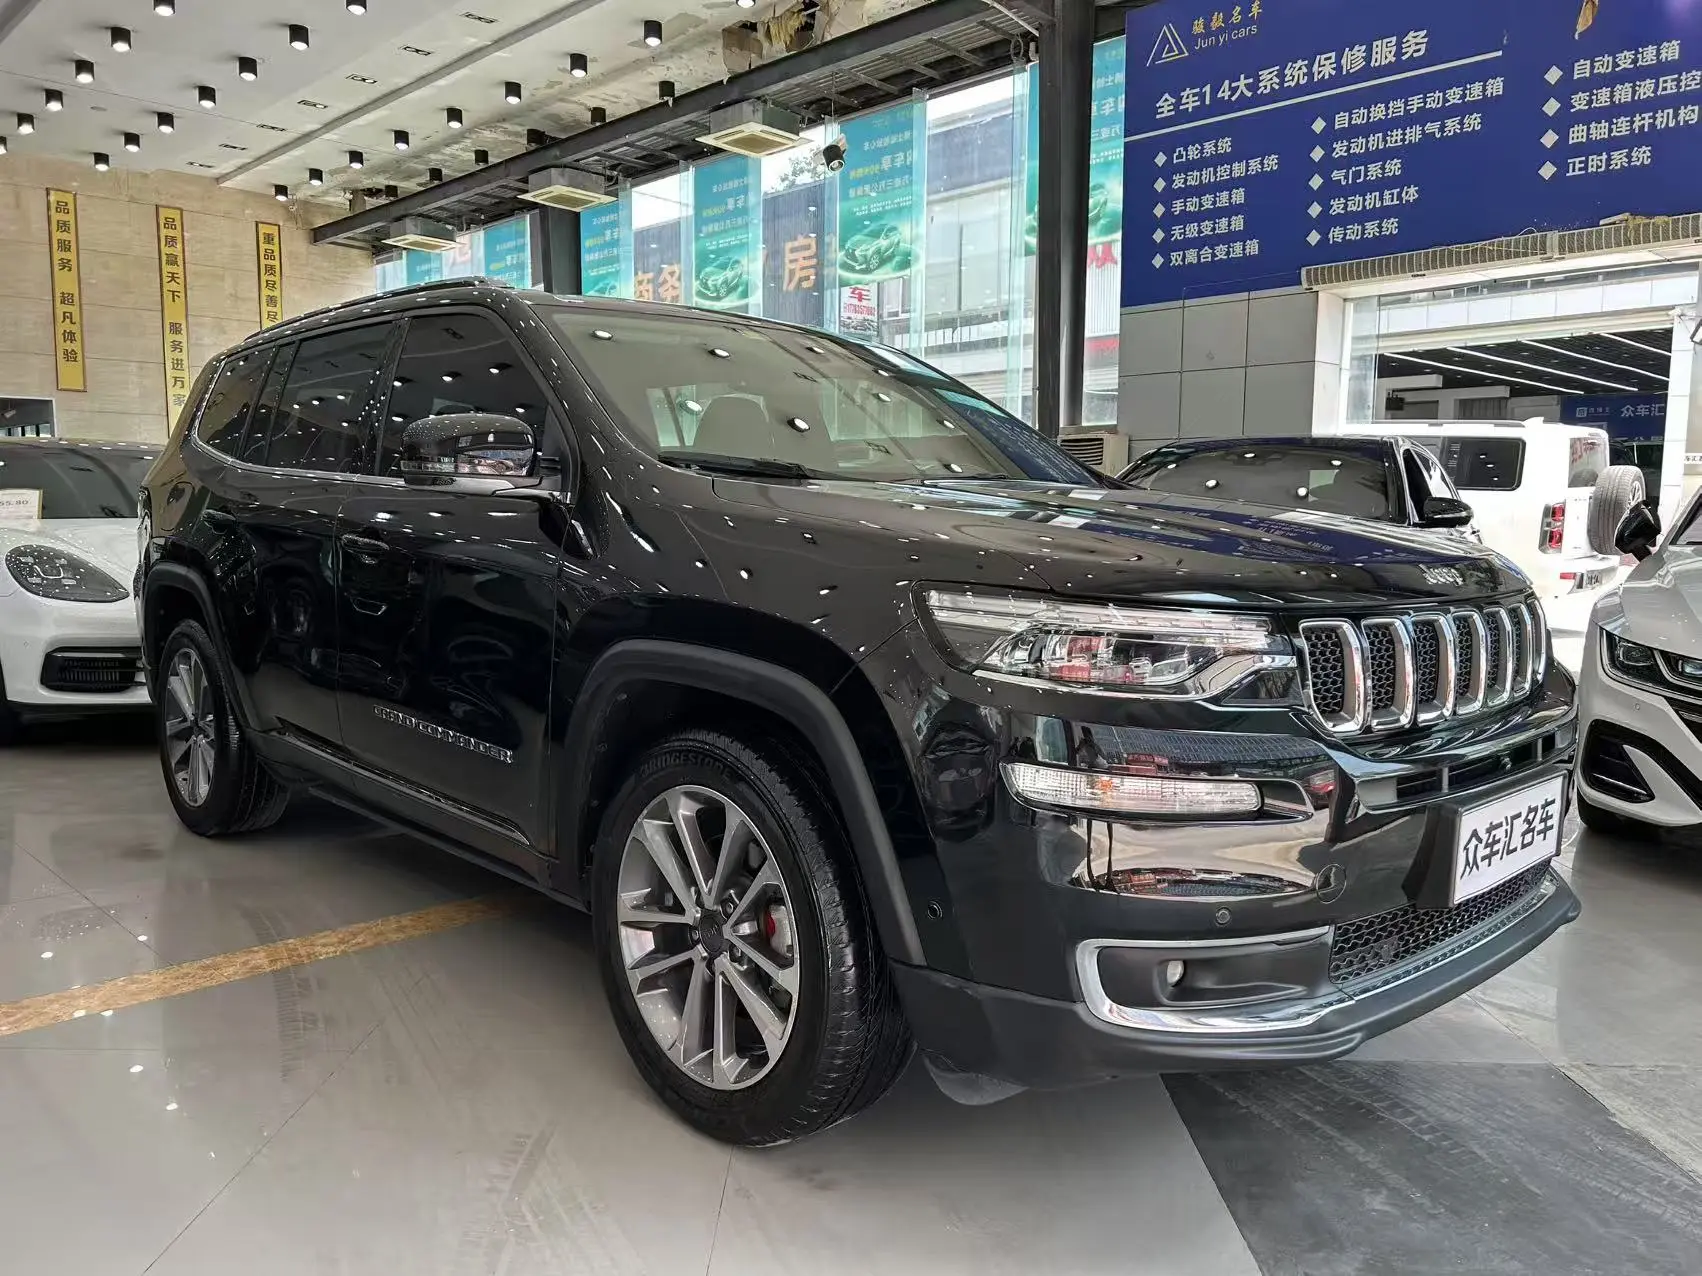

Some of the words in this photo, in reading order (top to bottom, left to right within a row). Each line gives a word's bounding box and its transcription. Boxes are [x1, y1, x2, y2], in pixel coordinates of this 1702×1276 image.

[1194, 34, 1215, 50] Jun
[1218, 29, 1228, 46] yi
[1231, 24, 1258, 40] cars
[1155, 30, 1429, 119] 全车14大系统保修服务
[1573, 40, 1681, 80] 自动变速箱
[1334, 76, 1505, 130] 自动换挡手动变速箱
[1570, 70, 1702, 112] 变速箱液压控
[1331, 112, 1483, 159] 发动机进排气系统
[1568, 104, 1700, 145] 曲轴连杆机构
[1172, 137, 1232, 164] 凸轮系统
[1566, 146, 1652, 177] 正时系统
[1171, 154, 1279, 189] 发动机控制系统
[1331, 158, 1402, 186] 气门系统
[1171, 187, 1245, 215] 手动变速箱
[1329, 185, 1419, 216] 发动机缸体
[54, 200, 74, 273] 品质服务
[1170, 215, 1245, 241] 无级变速箱
[1328, 217, 1400, 244] 传动系统
[163, 216, 182, 304] 品质赢天下
[1169, 239, 1260, 266] 双离合变速箱
[262, 231, 279, 323] 重品质尽善尽
[58, 291, 79, 364] 超凡体验
[168, 321, 187, 407] 服务进万家
[1620, 403, 1666, 417] 众车汇
[1460, 797, 1556, 881] 众车汇名车
